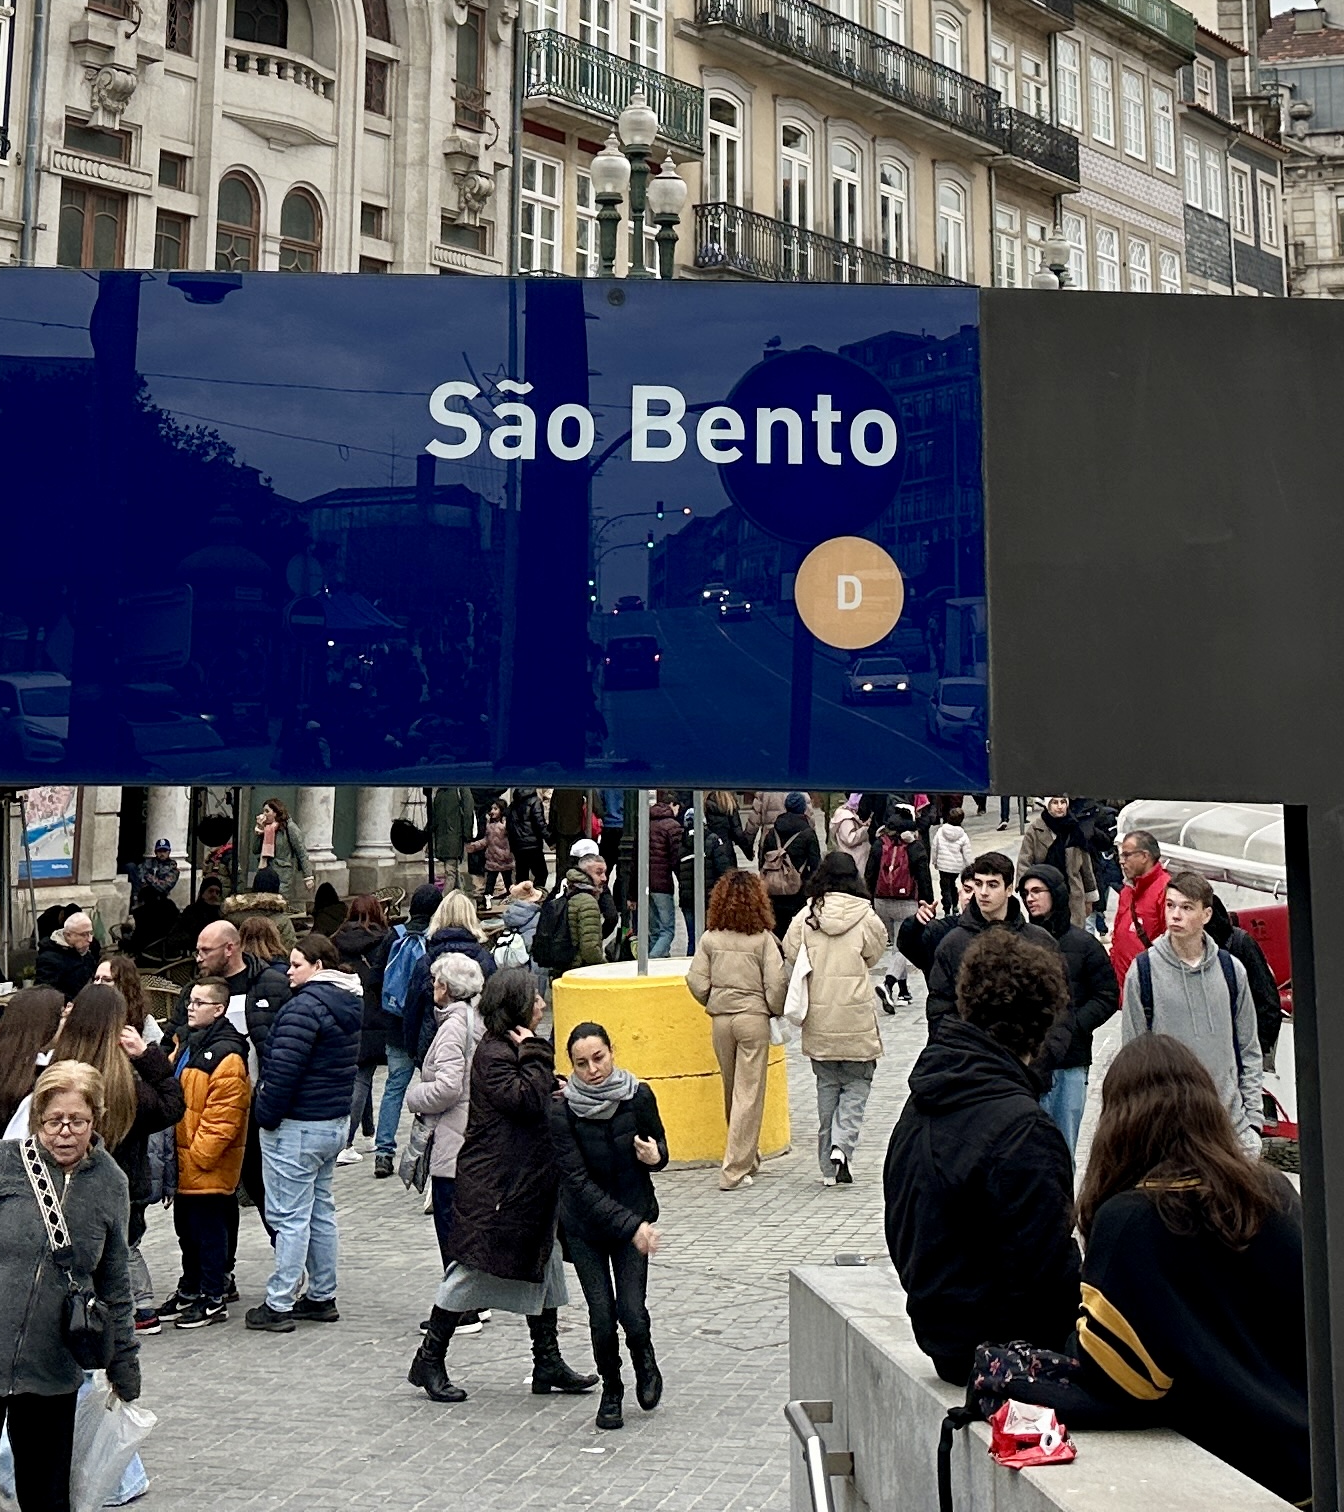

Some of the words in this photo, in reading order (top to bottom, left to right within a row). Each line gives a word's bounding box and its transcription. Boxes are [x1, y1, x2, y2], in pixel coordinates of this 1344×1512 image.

[424, 380, 596, 462] São
[630, 384, 899, 468] Bento
[836, 574, 863, 611] D
